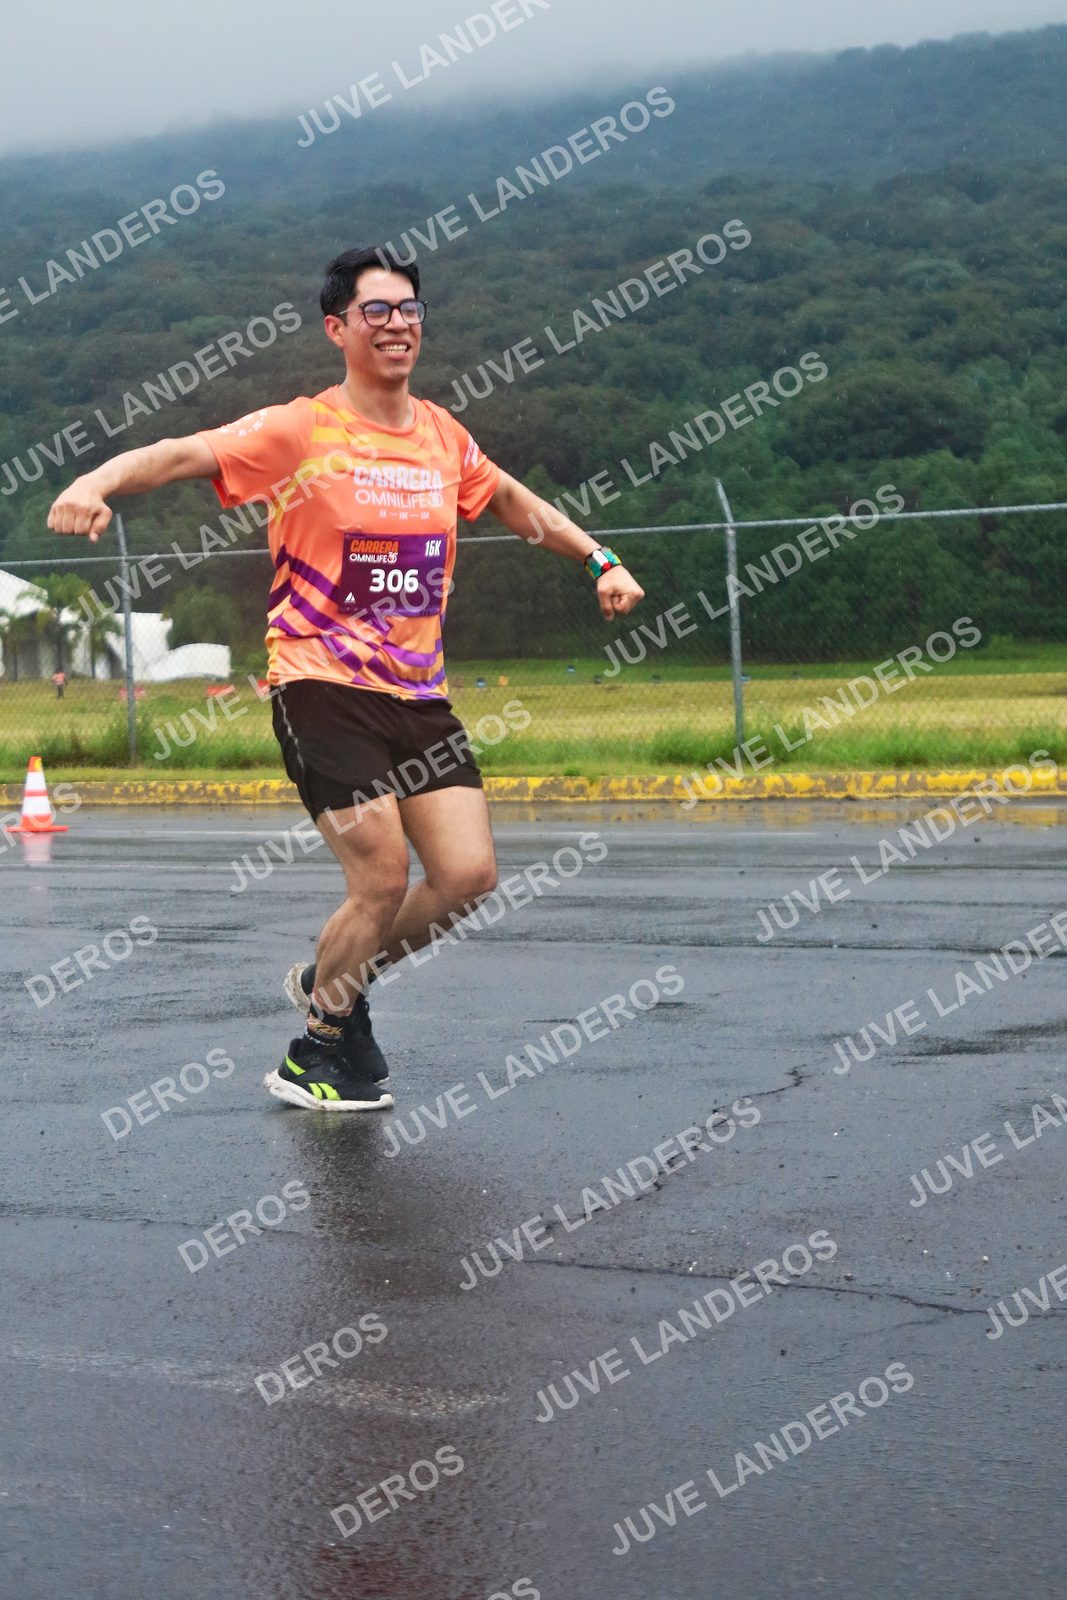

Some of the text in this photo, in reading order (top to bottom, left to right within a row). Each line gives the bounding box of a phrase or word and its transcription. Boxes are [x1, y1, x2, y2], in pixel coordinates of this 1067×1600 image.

[354, 466, 443, 489] CARRERA
[350, 540, 399, 554] CARRERA
[369, 568, 419, 593] 306
